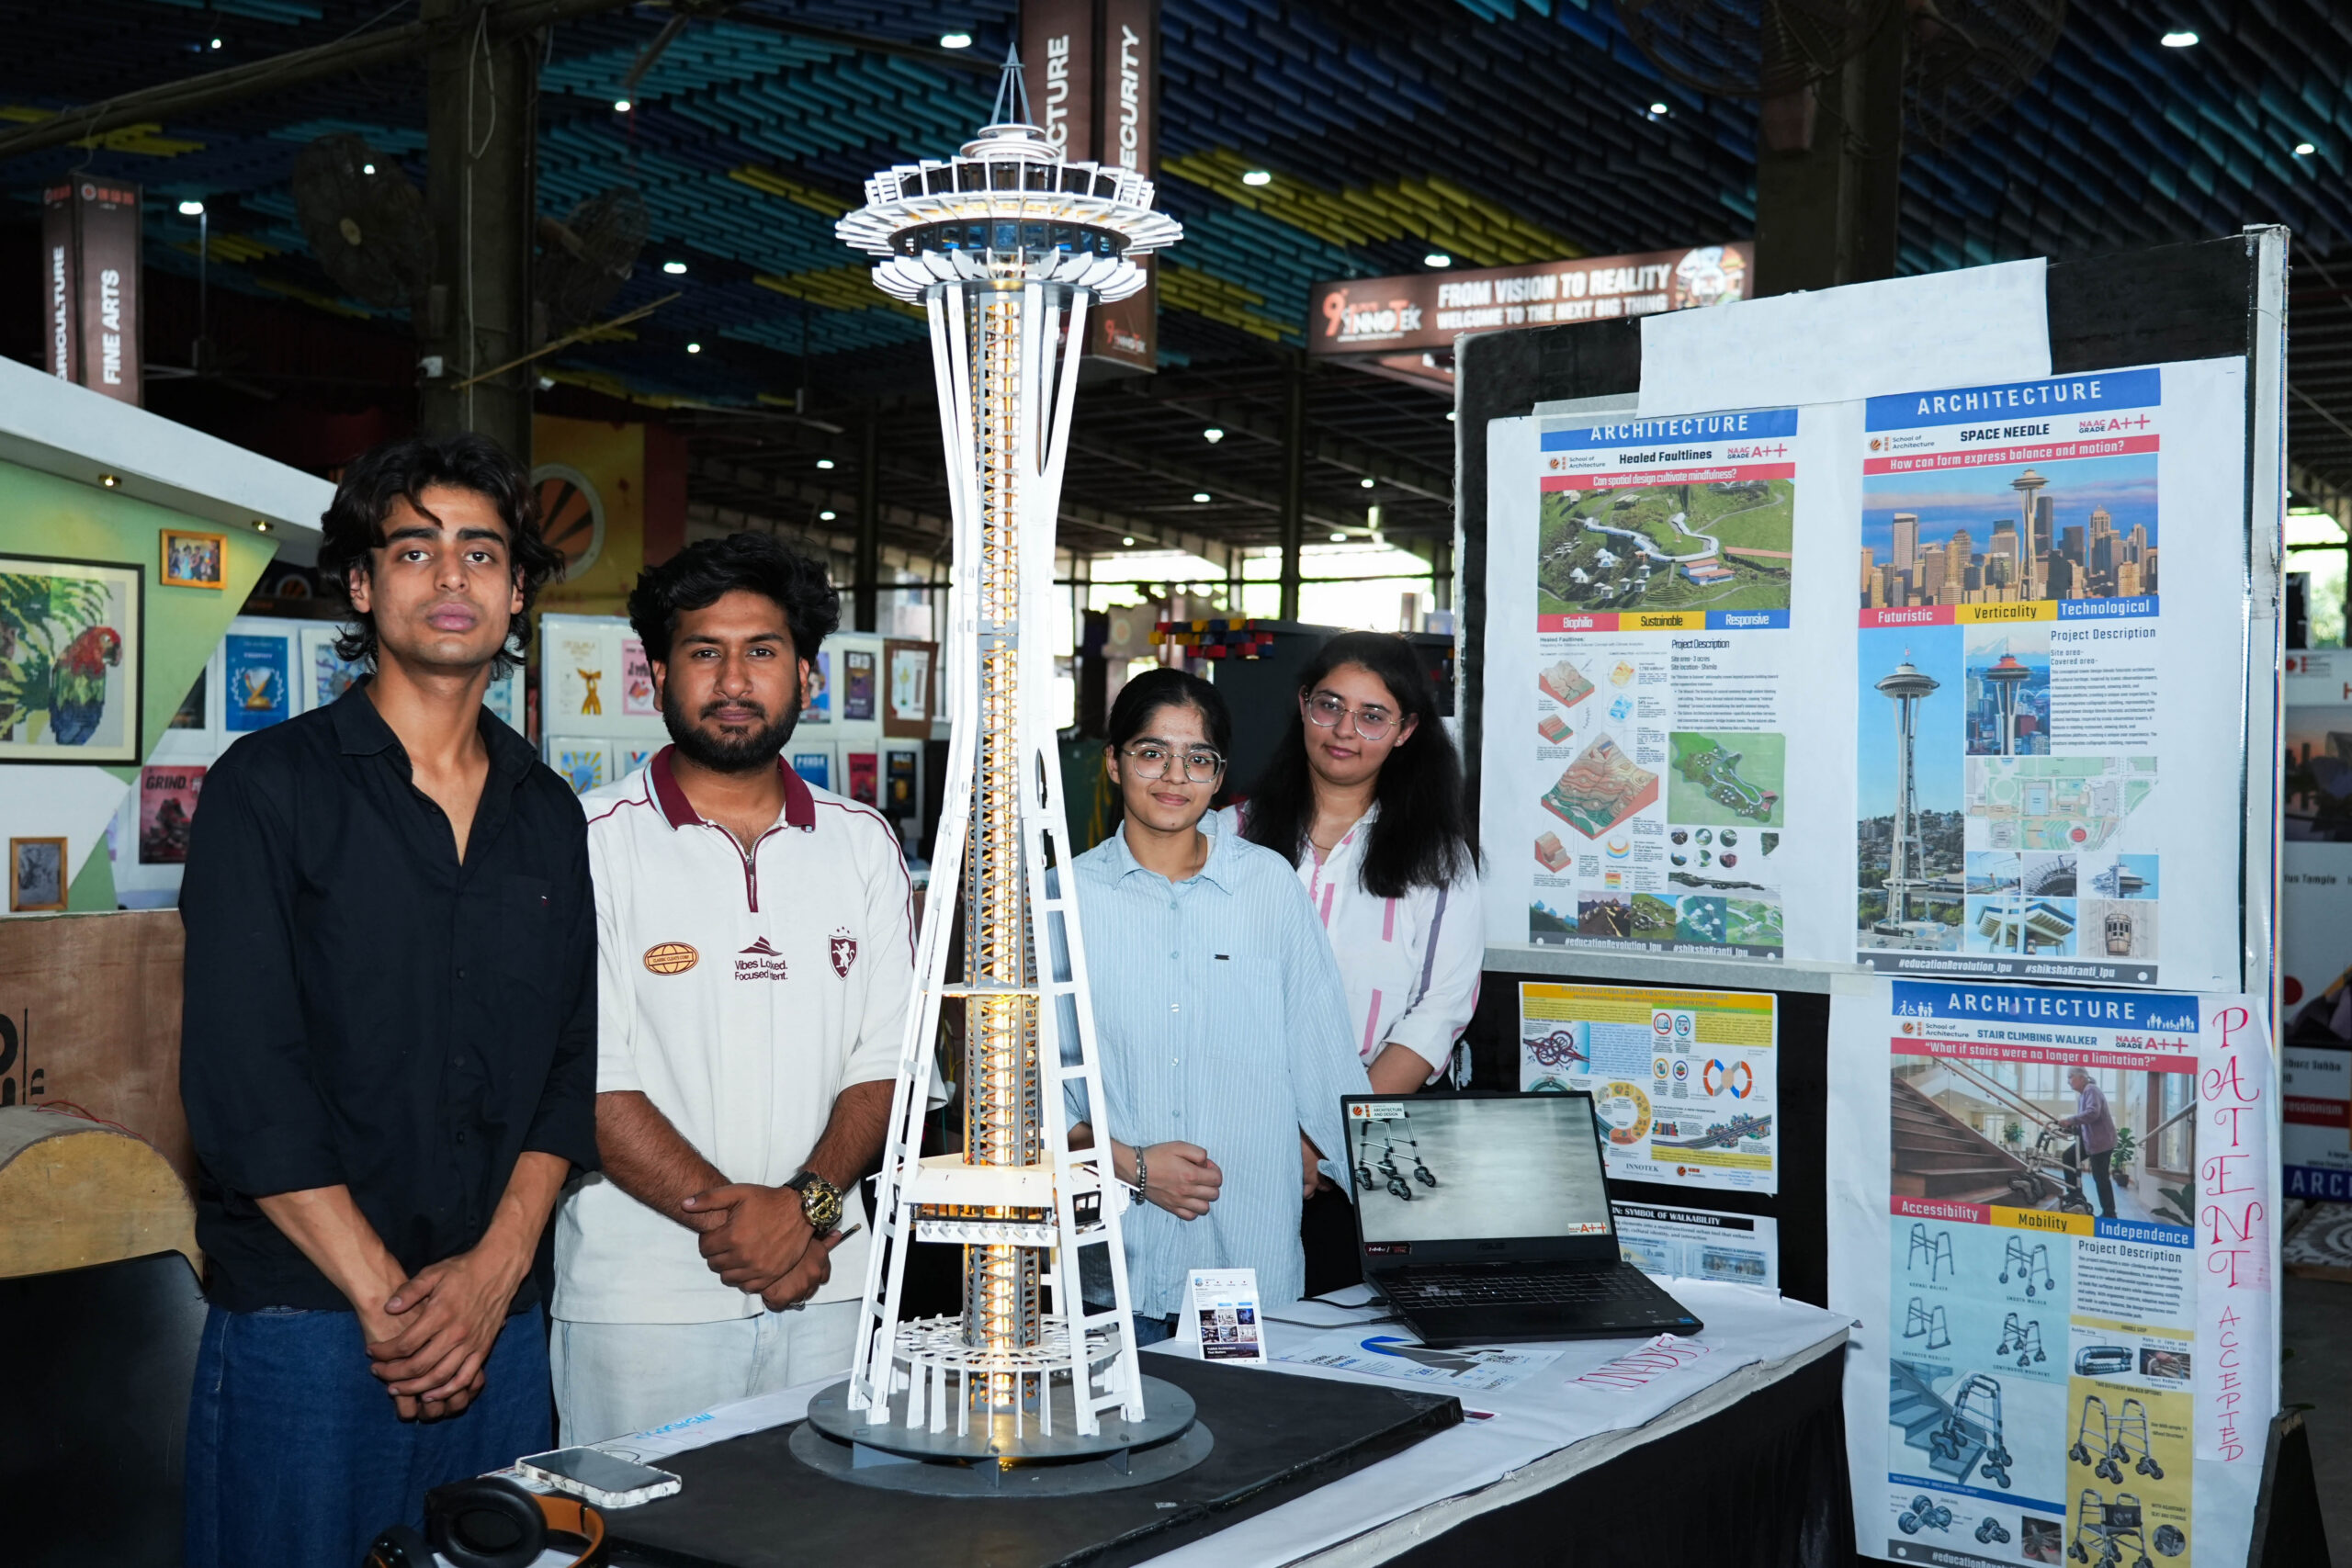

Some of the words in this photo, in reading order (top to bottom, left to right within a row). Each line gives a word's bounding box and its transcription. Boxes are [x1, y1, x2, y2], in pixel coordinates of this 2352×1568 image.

[1046, 35, 1069, 164] CTURE
[1119, 24, 1139, 171] ECURITY
[1438, 280, 1491, 309] FROM
[1494, 275, 1557, 304] VISION
[1560, 271, 1587, 298] TO
[1589, 264, 1672, 297] REALITY
[101, 269, 119, 331] ARTS
[1437, 307, 1503, 330] WELCOME
[1506, 305, 1524, 324] TO
[1526, 304, 1553, 322] THE
[1555, 299, 1593, 321] NEXT
[1595, 298, 1622, 317] BIG
[1623, 294, 1668, 315] THING
[103, 333, 121, 385] FINE
[1917, 380, 2101, 415] ARCHITECTURE
[1590, 415, 1748, 441] ARCHITECTURE
[2079, 419, 2106, 428] NAAC
[2079, 425, 2106, 434] GRADE
[2108, 413, 2151, 431] A++
[1961, 428, 2000, 442] SPACE
[2004, 423, 2050, 438] NEEDLE
[1752, 444, 1788, 457] A++
[1893, 441, 1935, 449] Architecture
[1620, 452, 1656, 464] Healed
[1659, 449, 1712, 461] Faultlines
[1890, 458, 1912, 470] How
[1915, 457, 1934, 468] can
[1937, 455, 1961, 467] form
[1964, 451, 2006, 466] express
[2009, 447, 2052, 461] balance
[2056, 445, 2075, 457] and
[2079, 440, 2124, 455] motion?
[1593, 476, 1607, 487] Can
[1608, 474, 1631, 487] spatial
[1632, 473, 1656, 486] design
[1657, 471, 1688, 484] cultivate
[1688, 468, 1736, 481] mindfulness?
[1974, 604, 2037, 620] Verticality
[2061, 598, 2150, 616] Technological
[1641, 615, 1683, 627] Sustainable
[1725, 614, 1770, 627] Responsive
[1878, 610, 1933, 624] Futuristic
[2051, 629, 2089, 642] Project
[2093, 626, 2156, 640] Description
[1672, 639, 1693, 650] Project
[1694, 637, 1730, 650] Description
[2302, 874, 2336, 886] Temple
[735, 959, 757, 971] Vibes
[735, 970, 768, 981] Focused
[1948, 992, 2136, 1021] ARCHITECTURE
[1925, 1030, 1969, 1038] Architecture
[1977, 1029, 2005, 1039] STAIR
[2007, 1031, 2052, 1043] CLIMBING
[2055, 1034, 2098, 1046] WALKER
[2116, 1035, 2142, 1043] NAAC
[2116, 1041, 2143, 1050] GRADE
[2144, 1037, 2188, 1054] A++
[1959, 1044, 1967, 1055] if
[1970, 1045, 1998, 1058] stairs
[2001, 1048, 2027, 1059] were
[2030, 1050, 2042, 1060] no
[2046, 1049, 2079, 1065] longer
[2083, 1055, 2089, 1063] a
[2202, 1007, 2263, 1288] PATENT
[1626, 1163, 1658, 1172] INNOTEK
[1624, 1209, 1656, 1219] SYMBOL
[1657, 1211, 1668, 1219] OF
[1669, 1213, 1721, 1225] WALKABILITY
[1902, 1201, 1978, 1222] Accessibility
[1580, 1222, 1607, 1233] A++
[2018, 1213, 2067, 1232] Mobility
[2101, 1223, 2188, 1245] Independence
[2078, 1240, 2117, 1255] Project
[2120, 1245, 2182, 1262] Description
[2217, 1305, 2244, 1461] ACCEPTED
